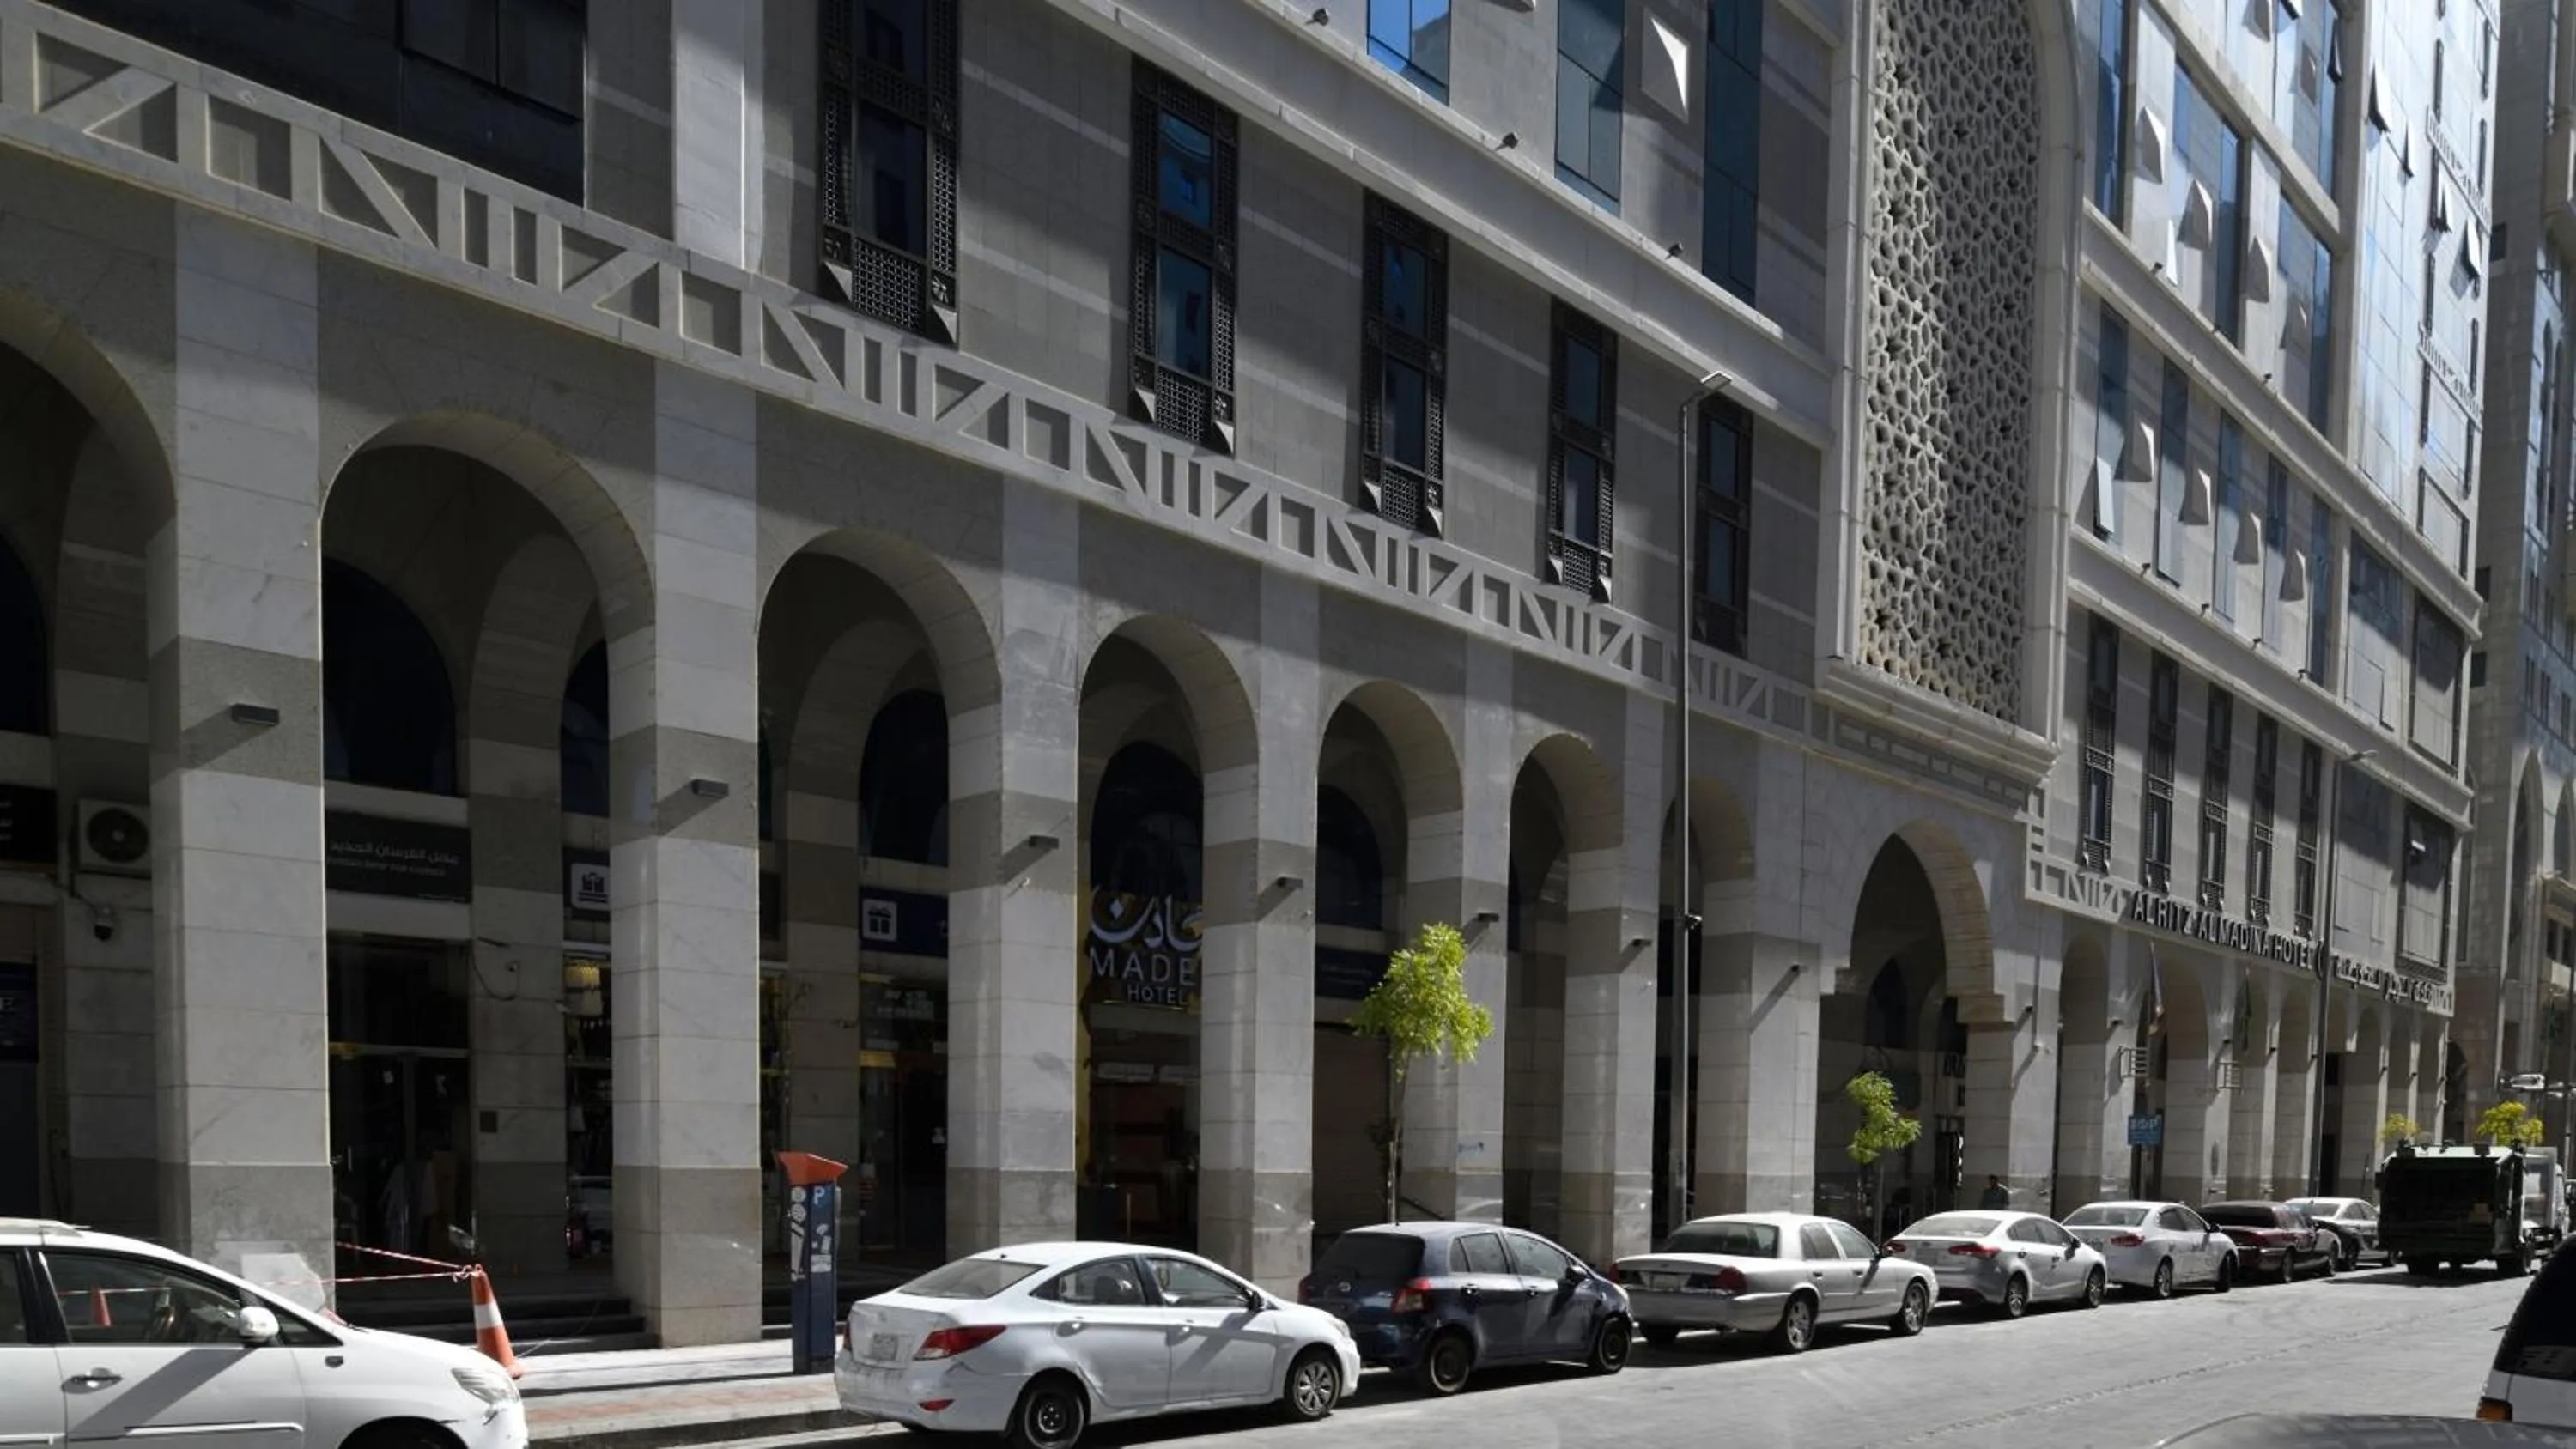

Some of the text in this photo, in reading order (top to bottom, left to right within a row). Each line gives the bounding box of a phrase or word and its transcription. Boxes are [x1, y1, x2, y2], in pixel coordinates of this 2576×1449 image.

[1089, 946, 1196, 986] MADE
[2272, 932, 2316, 971] HOTEL
[1127, 983, 1186, 1005] HOTEL
